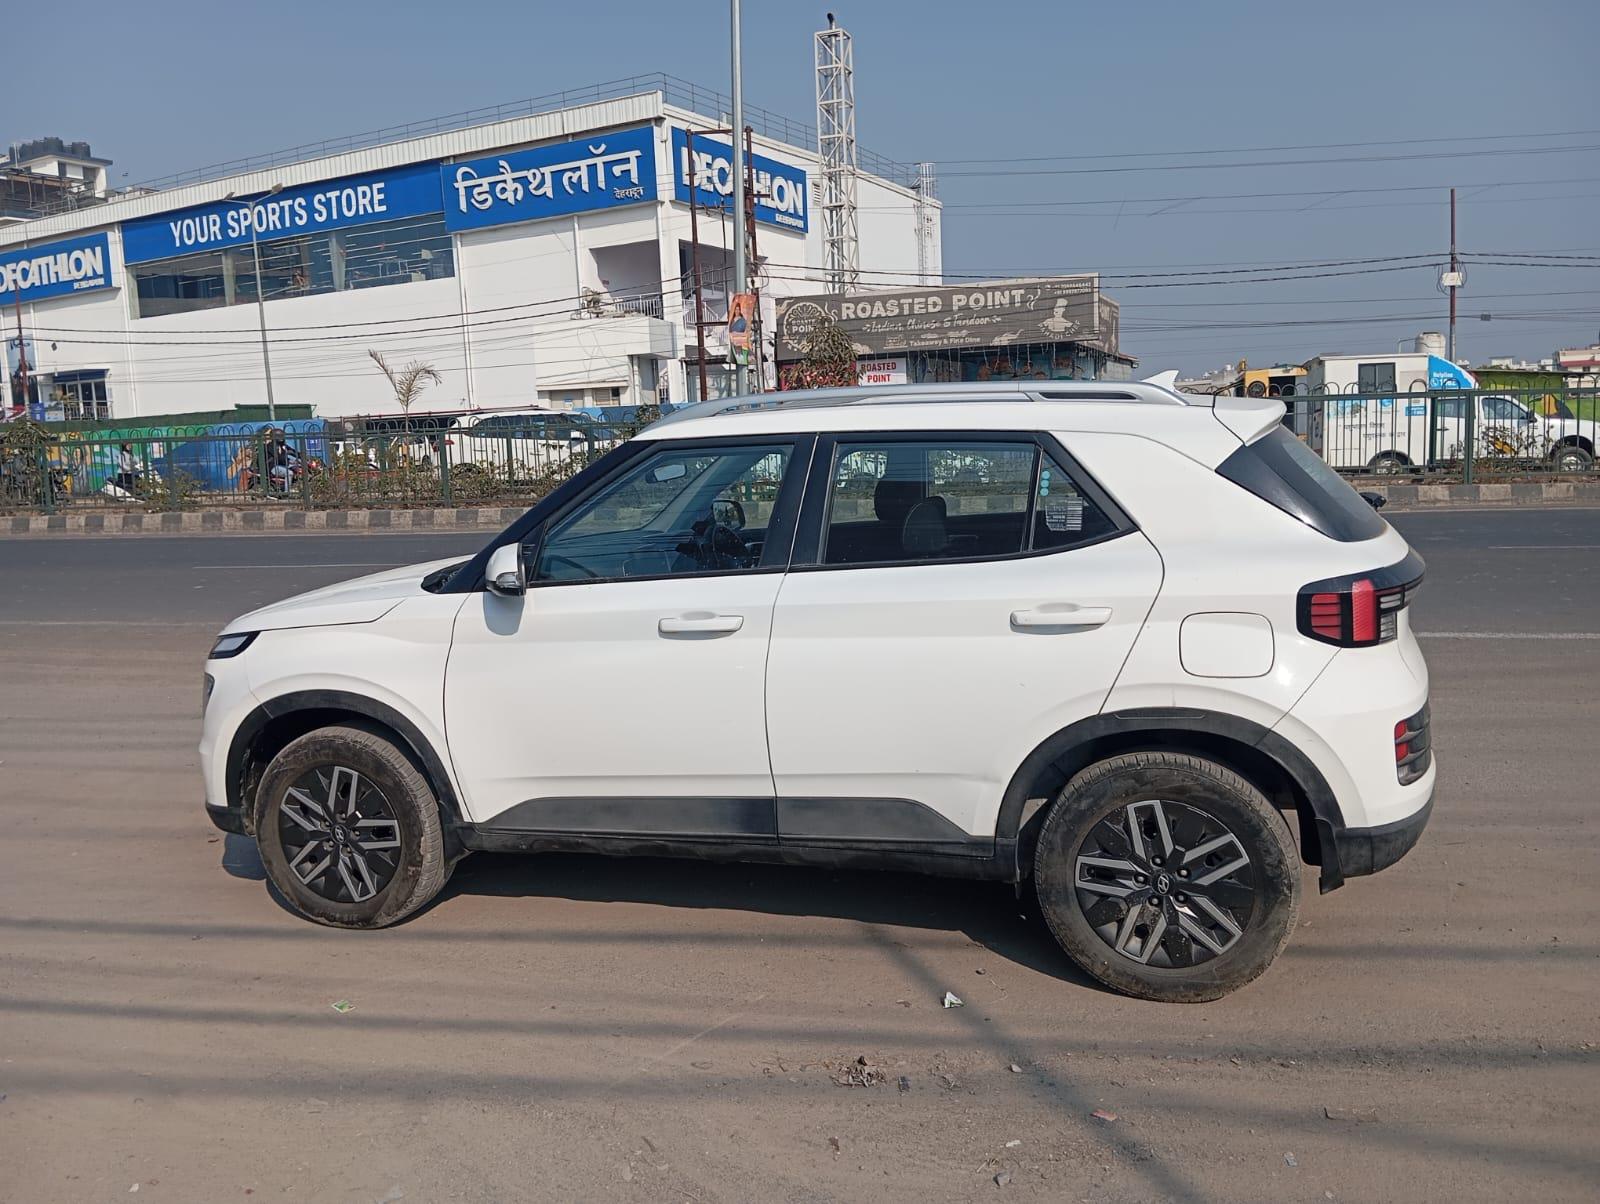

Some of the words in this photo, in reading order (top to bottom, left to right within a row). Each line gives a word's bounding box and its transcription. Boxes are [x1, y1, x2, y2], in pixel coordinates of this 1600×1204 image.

[453, 143, 642, 213] डिकैथलॉन
[681, 147, 804, 217] DECHLON
[170, 214, 222, 247] YOUR
[227, 197, 308, 238] SPORTS
[313, 182, 387, 223] STORE
[841, 296, 943, 320] ROASTED
[952, 289, 1025, 311] POINT
[792, 324, 816, 333] POIN
[952, 313, 991, 327] Tandoor
[861, 362, 897, 371] ROASTED
[867, 373, 891, 383] POINT
